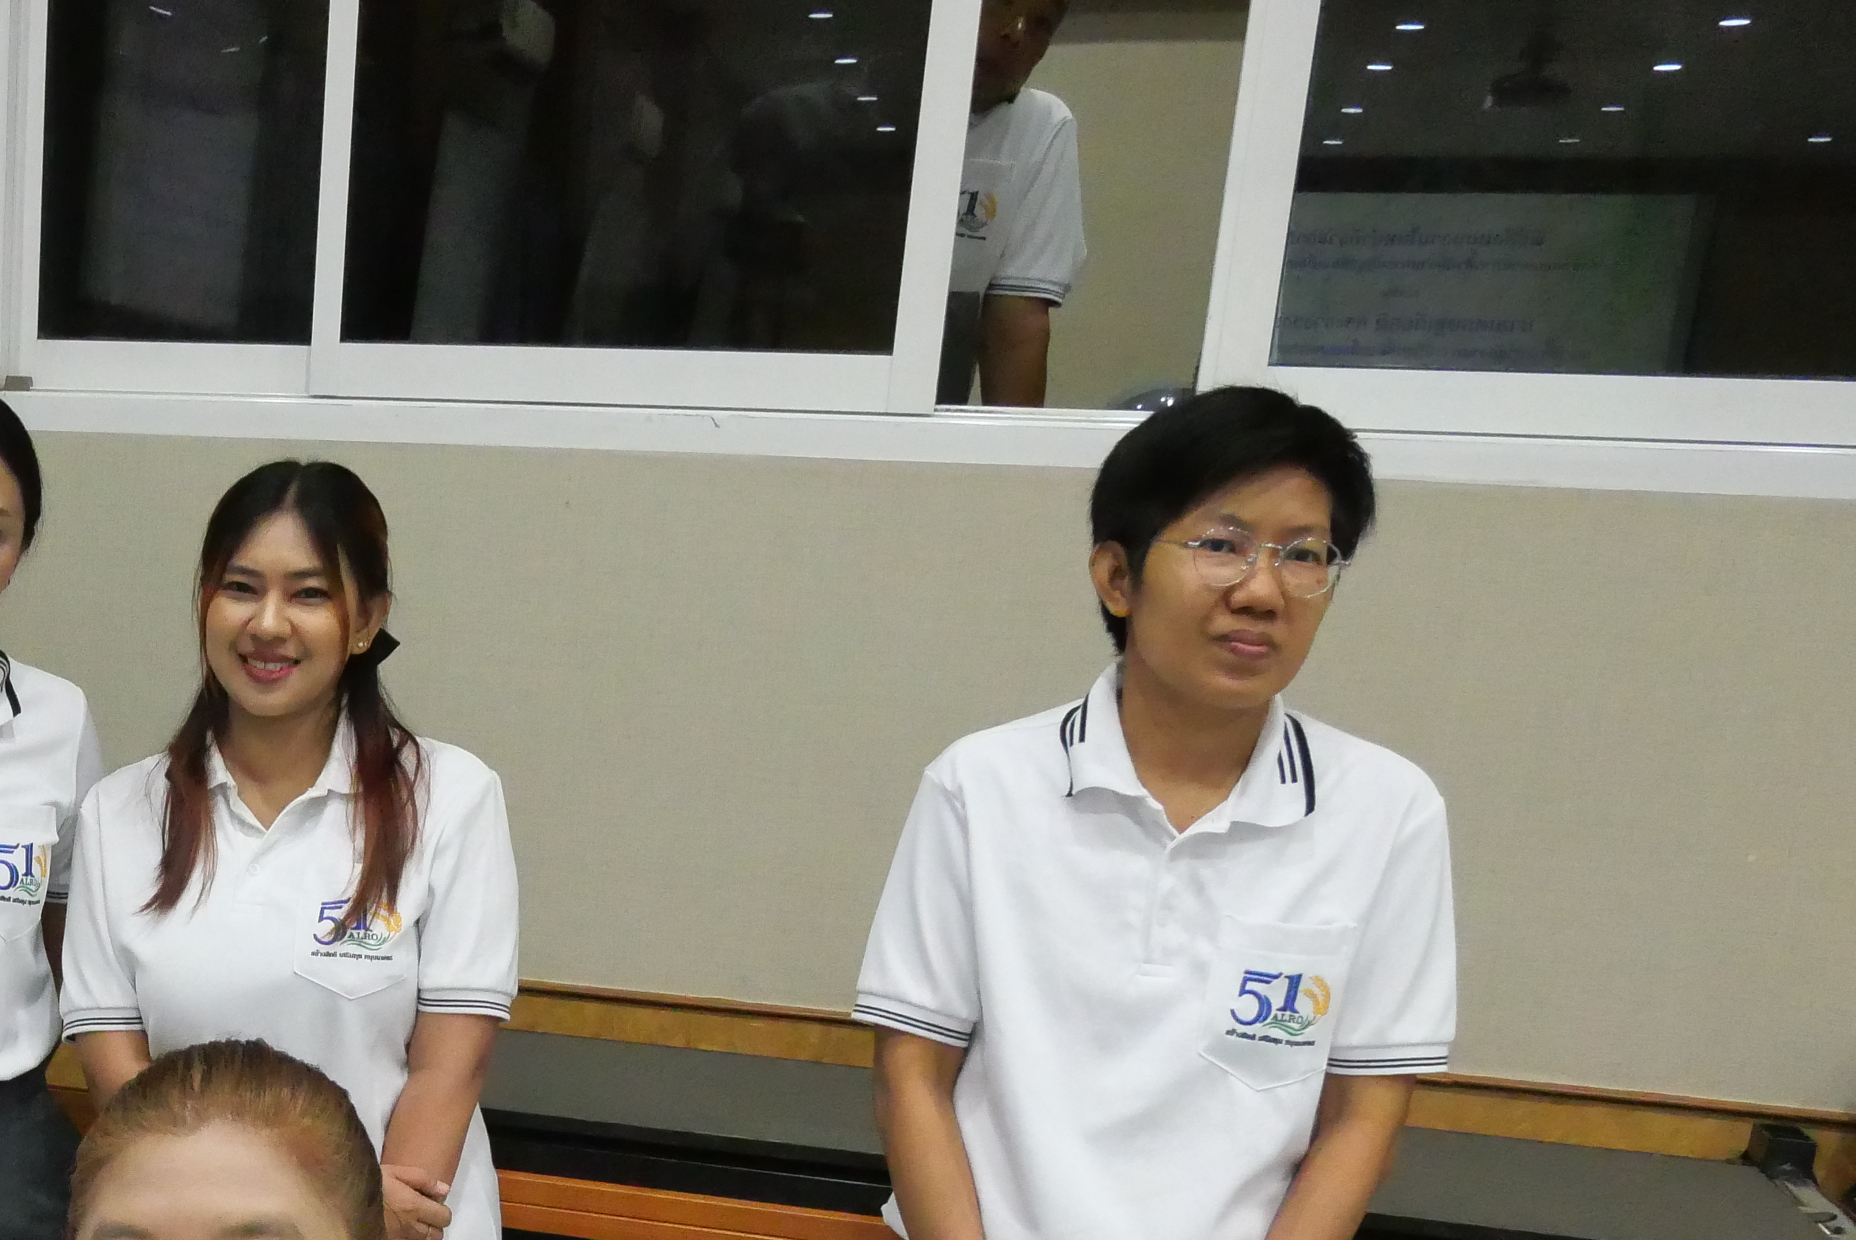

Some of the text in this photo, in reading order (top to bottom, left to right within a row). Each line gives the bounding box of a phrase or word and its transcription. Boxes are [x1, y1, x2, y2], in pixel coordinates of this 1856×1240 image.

[347, 932, 379, 942] ALRO
[1230, 969, 1304, 1026] 51
[1270, 1013, 1304, 1025] ALRO
